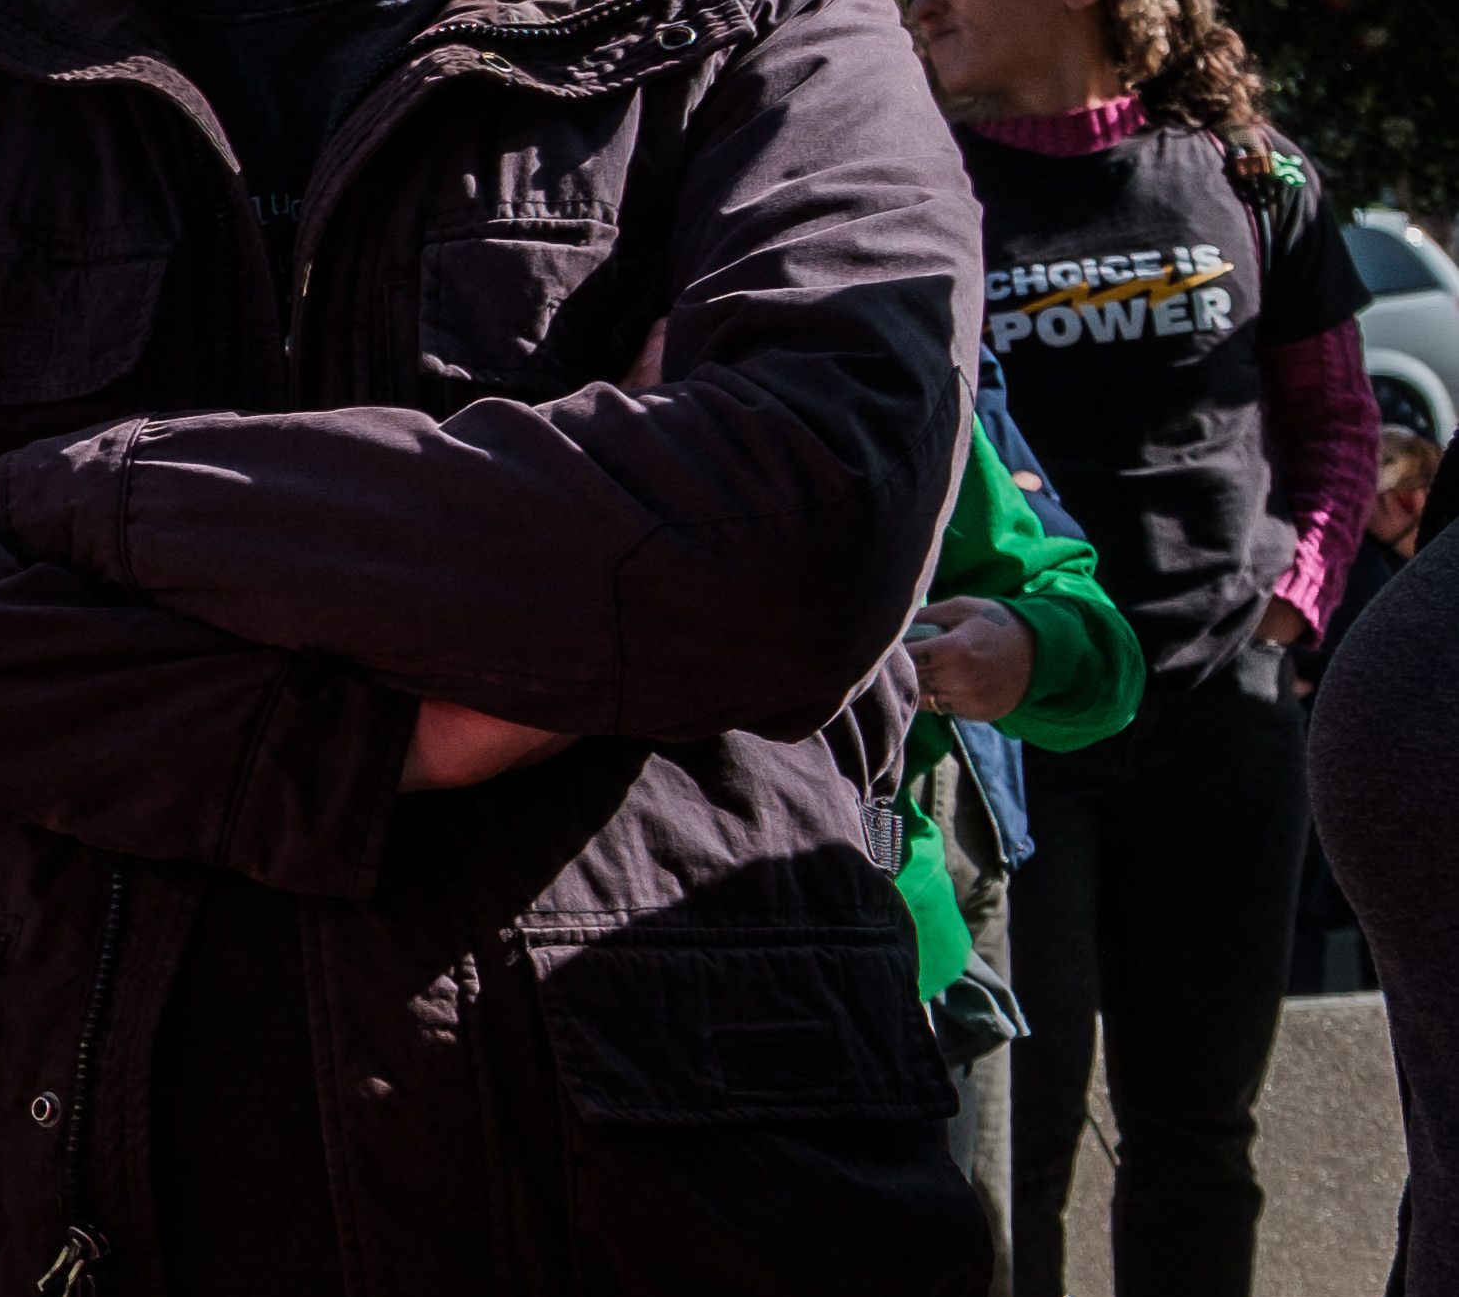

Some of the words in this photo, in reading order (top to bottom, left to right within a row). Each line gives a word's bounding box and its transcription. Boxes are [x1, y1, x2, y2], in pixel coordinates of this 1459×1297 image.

[985, 251, 1162, 300] CHOICE
[1173, 244, 1223, 276] IS
[989, 287, 1233, 353] POWER
